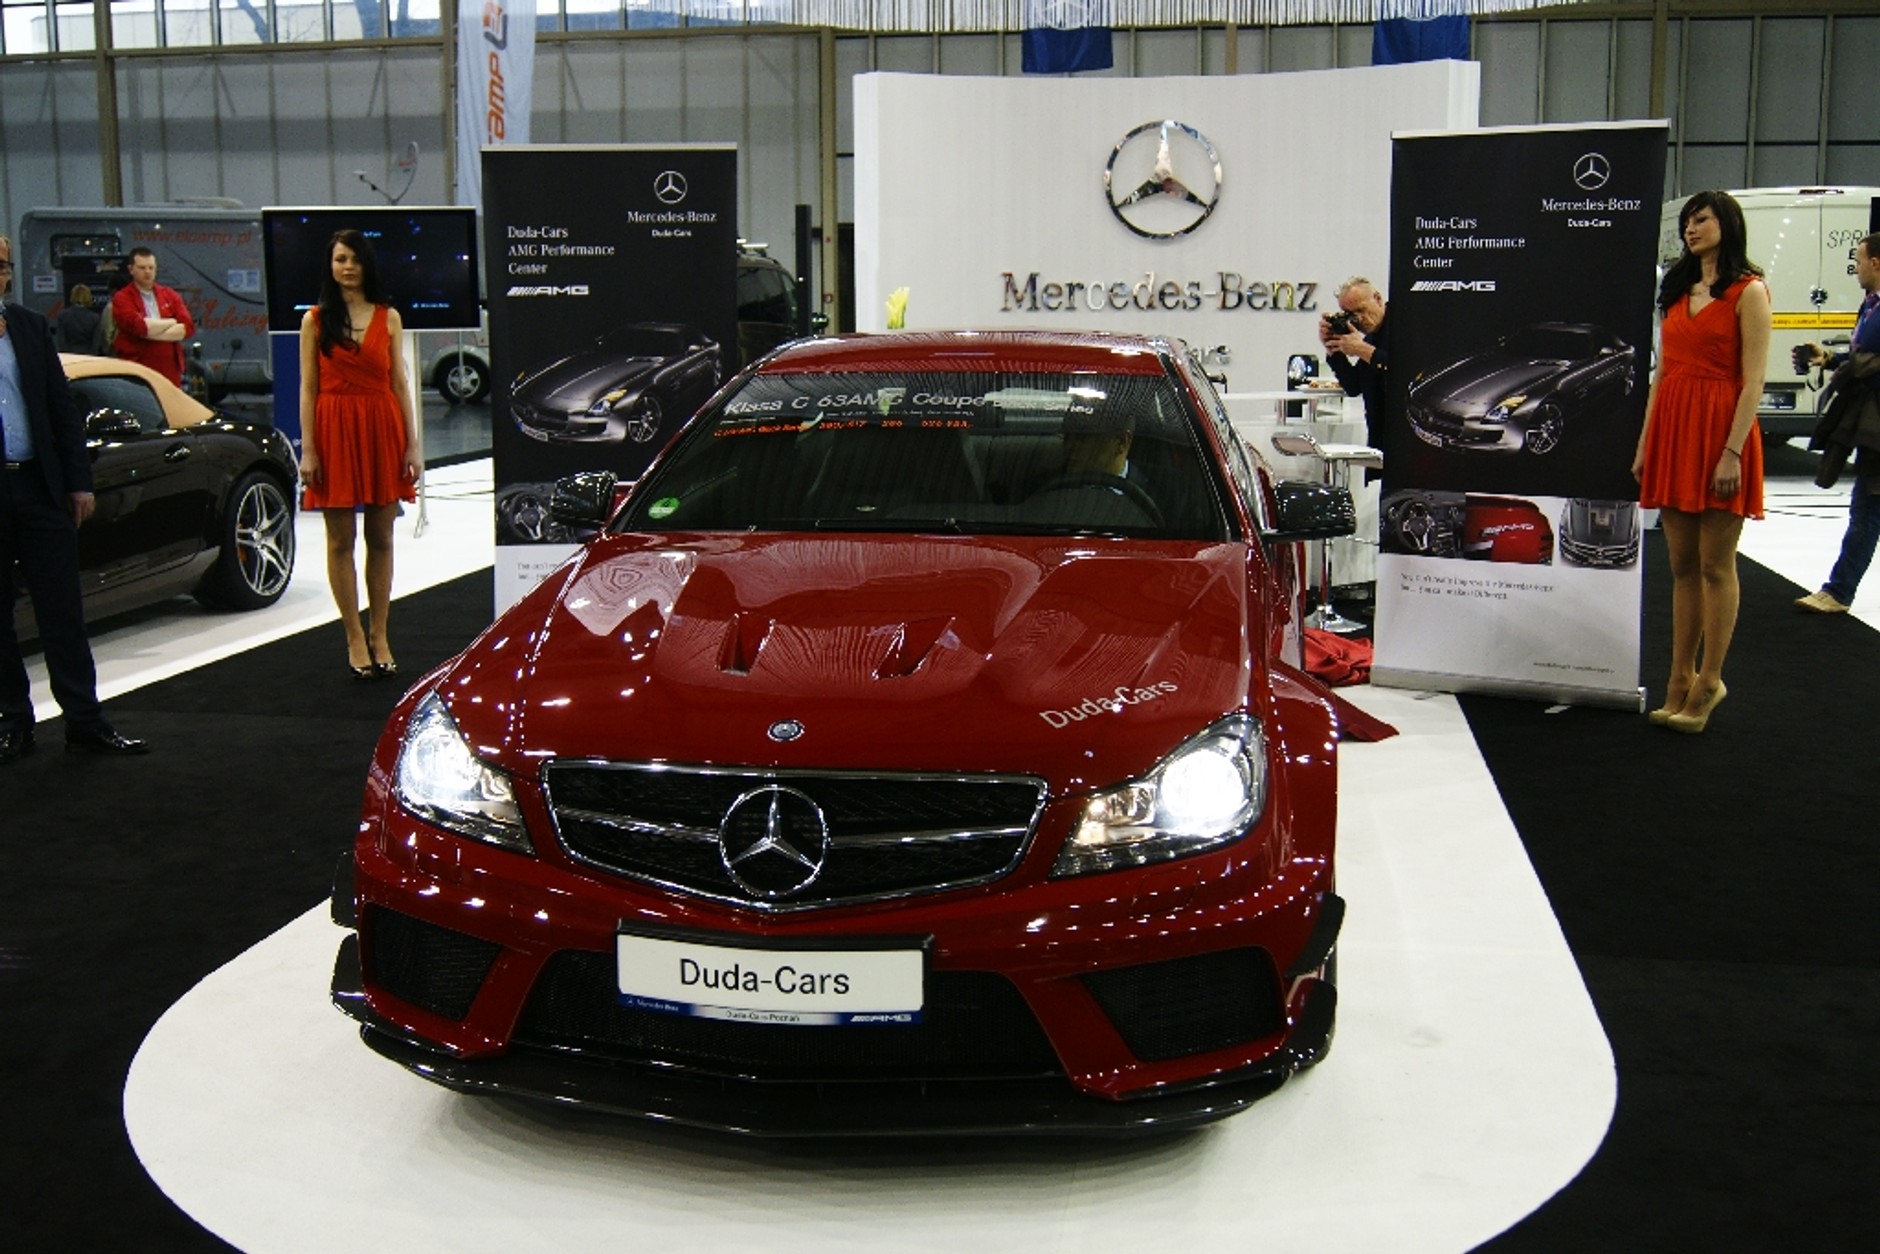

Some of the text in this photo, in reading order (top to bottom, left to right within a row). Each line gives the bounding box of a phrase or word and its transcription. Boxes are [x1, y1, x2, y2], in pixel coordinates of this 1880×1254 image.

[1541, 198, 1641, 212] Mercedes-Benz
[627, 211, 717, 223] Mercedes-Benz
[1415, 217, 1477, 230] Duda-Cars
[1567, 218, 1612, 228] Duda-Cars
[507, 225, 569, 238] Duda-Cars
[651, 229, 692, 237] Duda-Cars
[1415, 236, 1526, 249] AMG Performance
[508, 244, 615, 256] AMG Performance
[1413, 256, 1454, 268] Center
[508, 263, 548, 275] Center
[999, 271, 1318, 311] Mercedes-Benz
[791, 395, 810, 409] C
[1039, 680, 1178, 729] Duda-Cars
[679, 958, 850, 994] Duda-Cars
